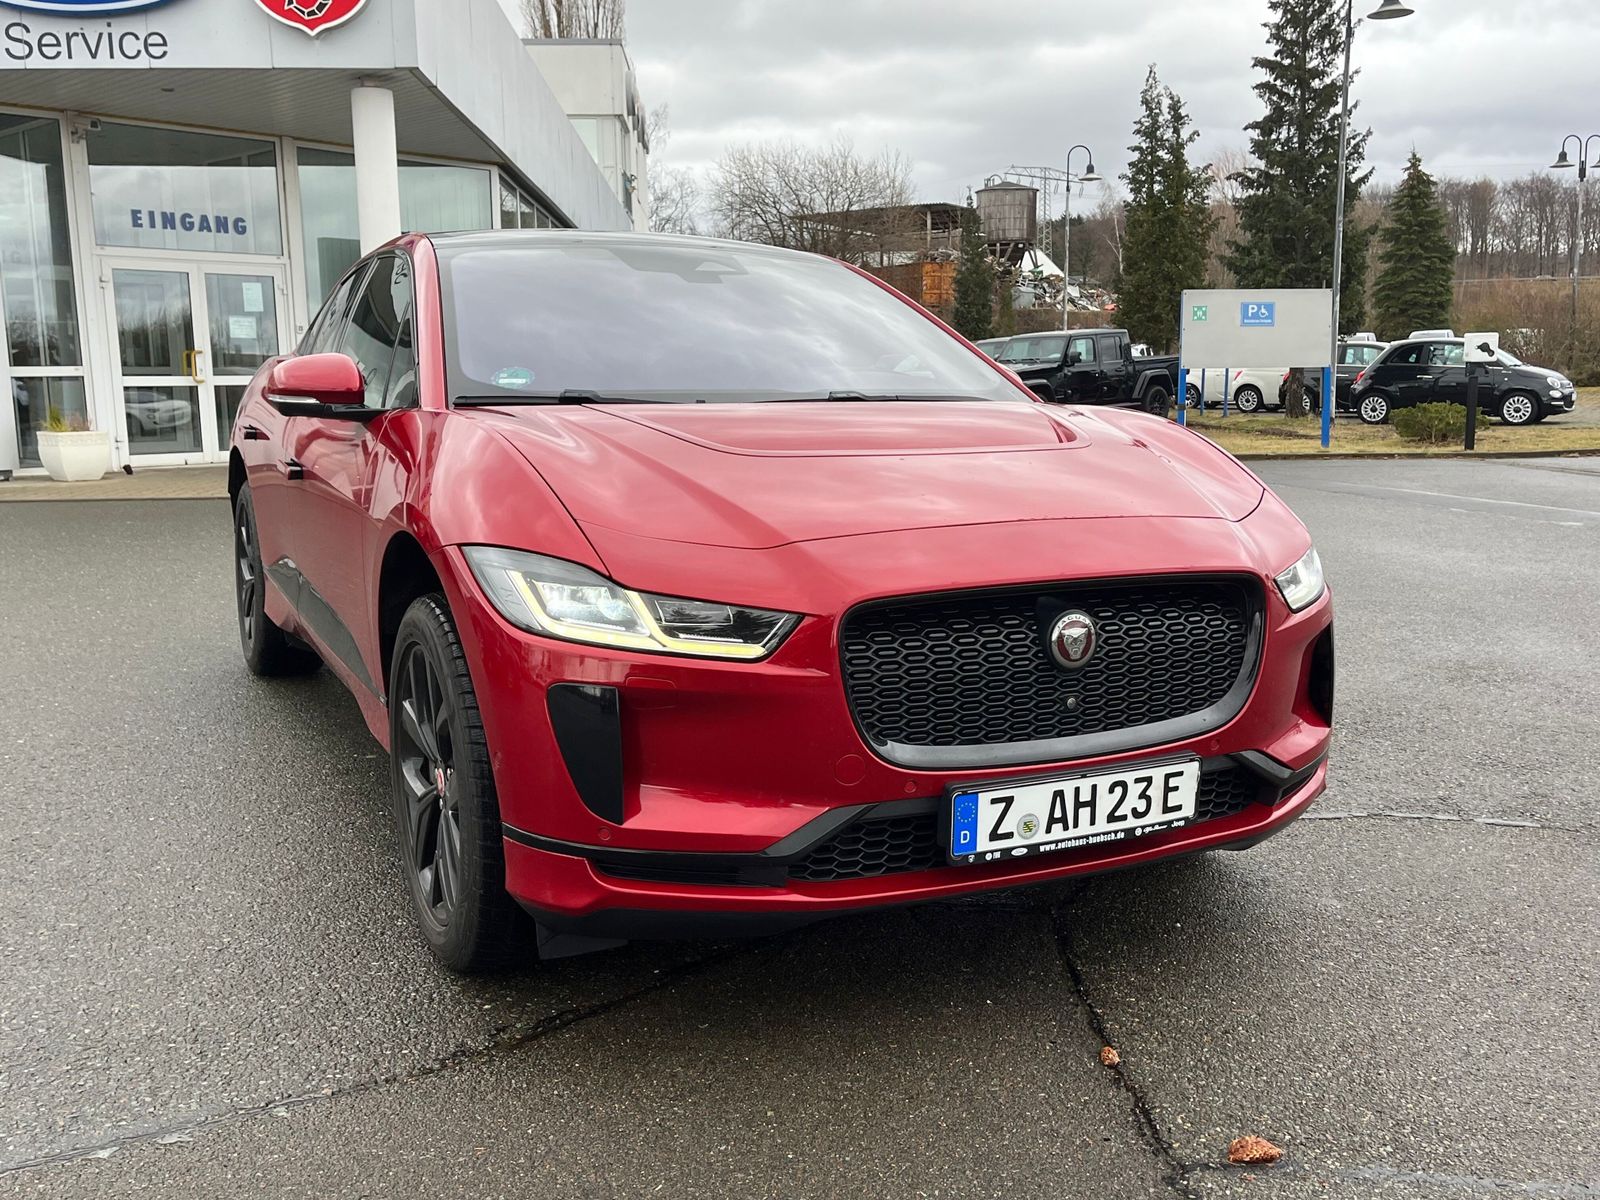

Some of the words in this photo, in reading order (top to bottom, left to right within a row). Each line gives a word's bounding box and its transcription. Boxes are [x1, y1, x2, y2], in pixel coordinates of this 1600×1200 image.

[4, 22, 169, 61] Service
[130, 208, 247, 236] EINGANG
[1248, 304, 1258, 317] P
[960, 830, 970, 844] D
